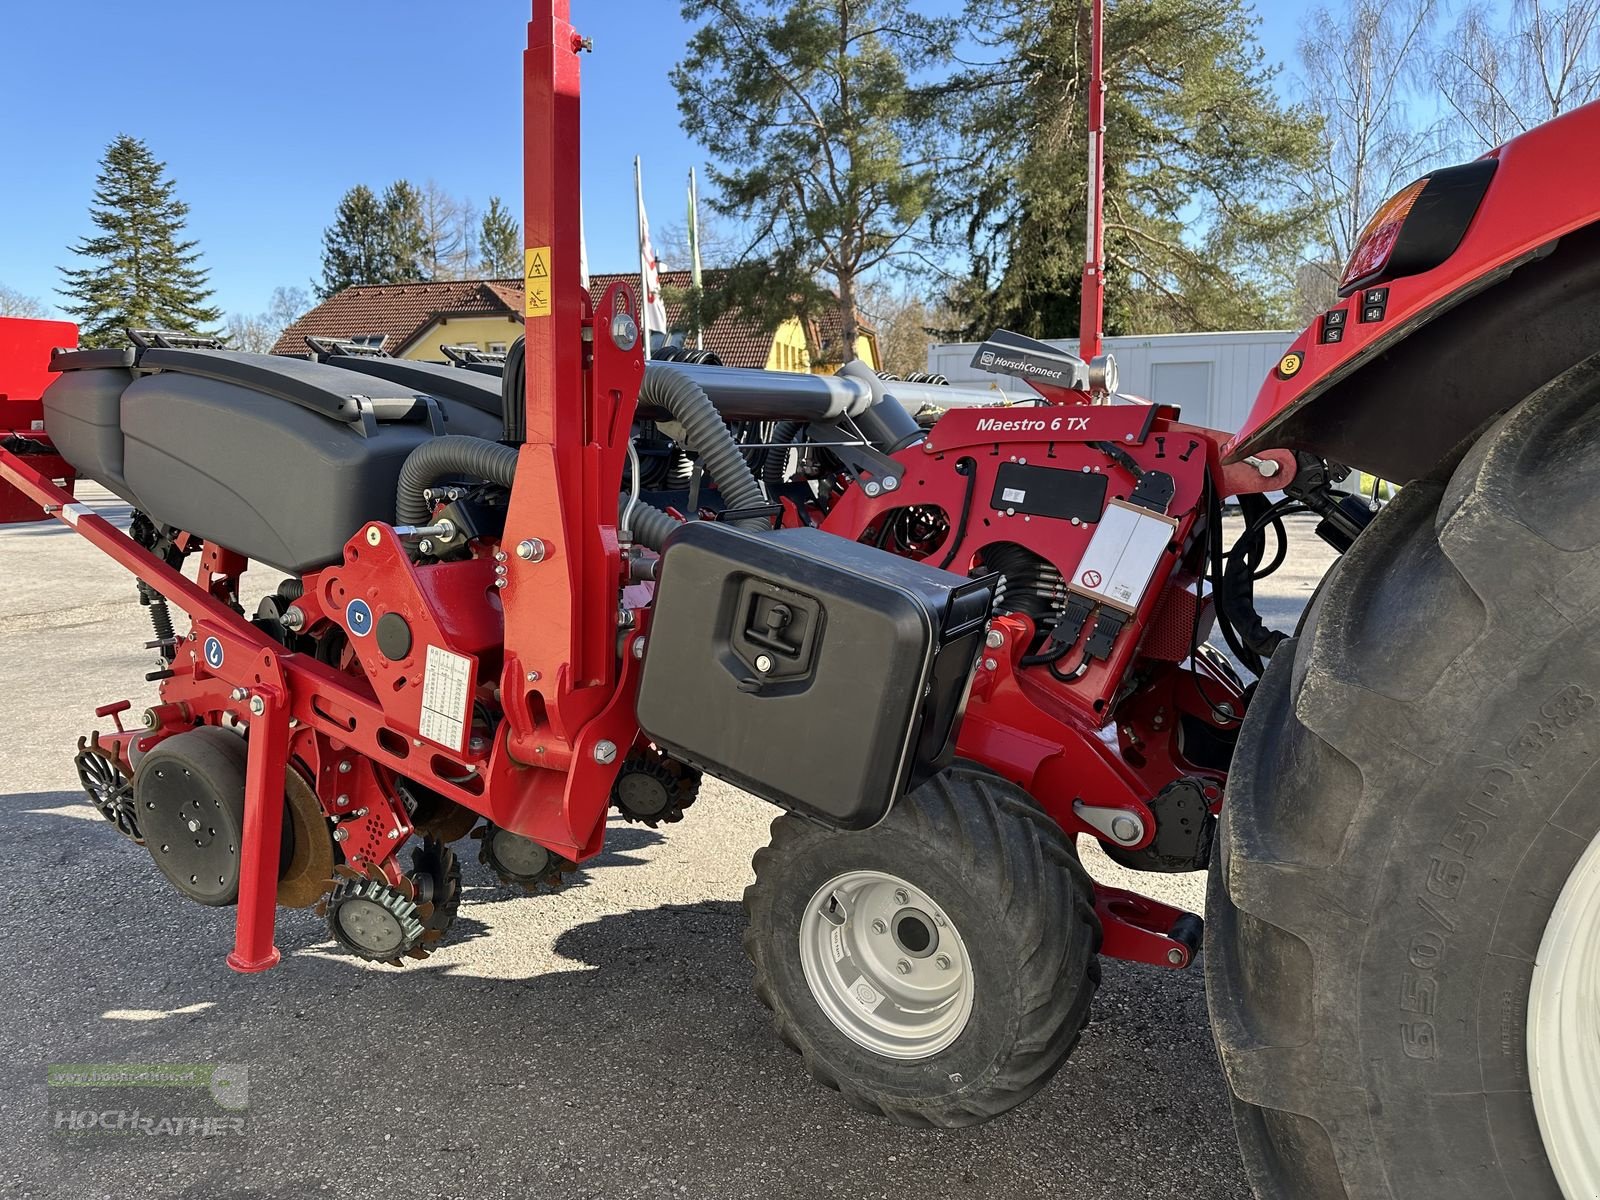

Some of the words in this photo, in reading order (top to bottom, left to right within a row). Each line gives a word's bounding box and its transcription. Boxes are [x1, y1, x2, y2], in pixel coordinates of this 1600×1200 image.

[994, 357, 1063, 379] HorschConnect
[976, 418, 1046, 431] Maestro
[1050, 417, 1062, 430] 6
[1067, 417, 1091, 430] TX
